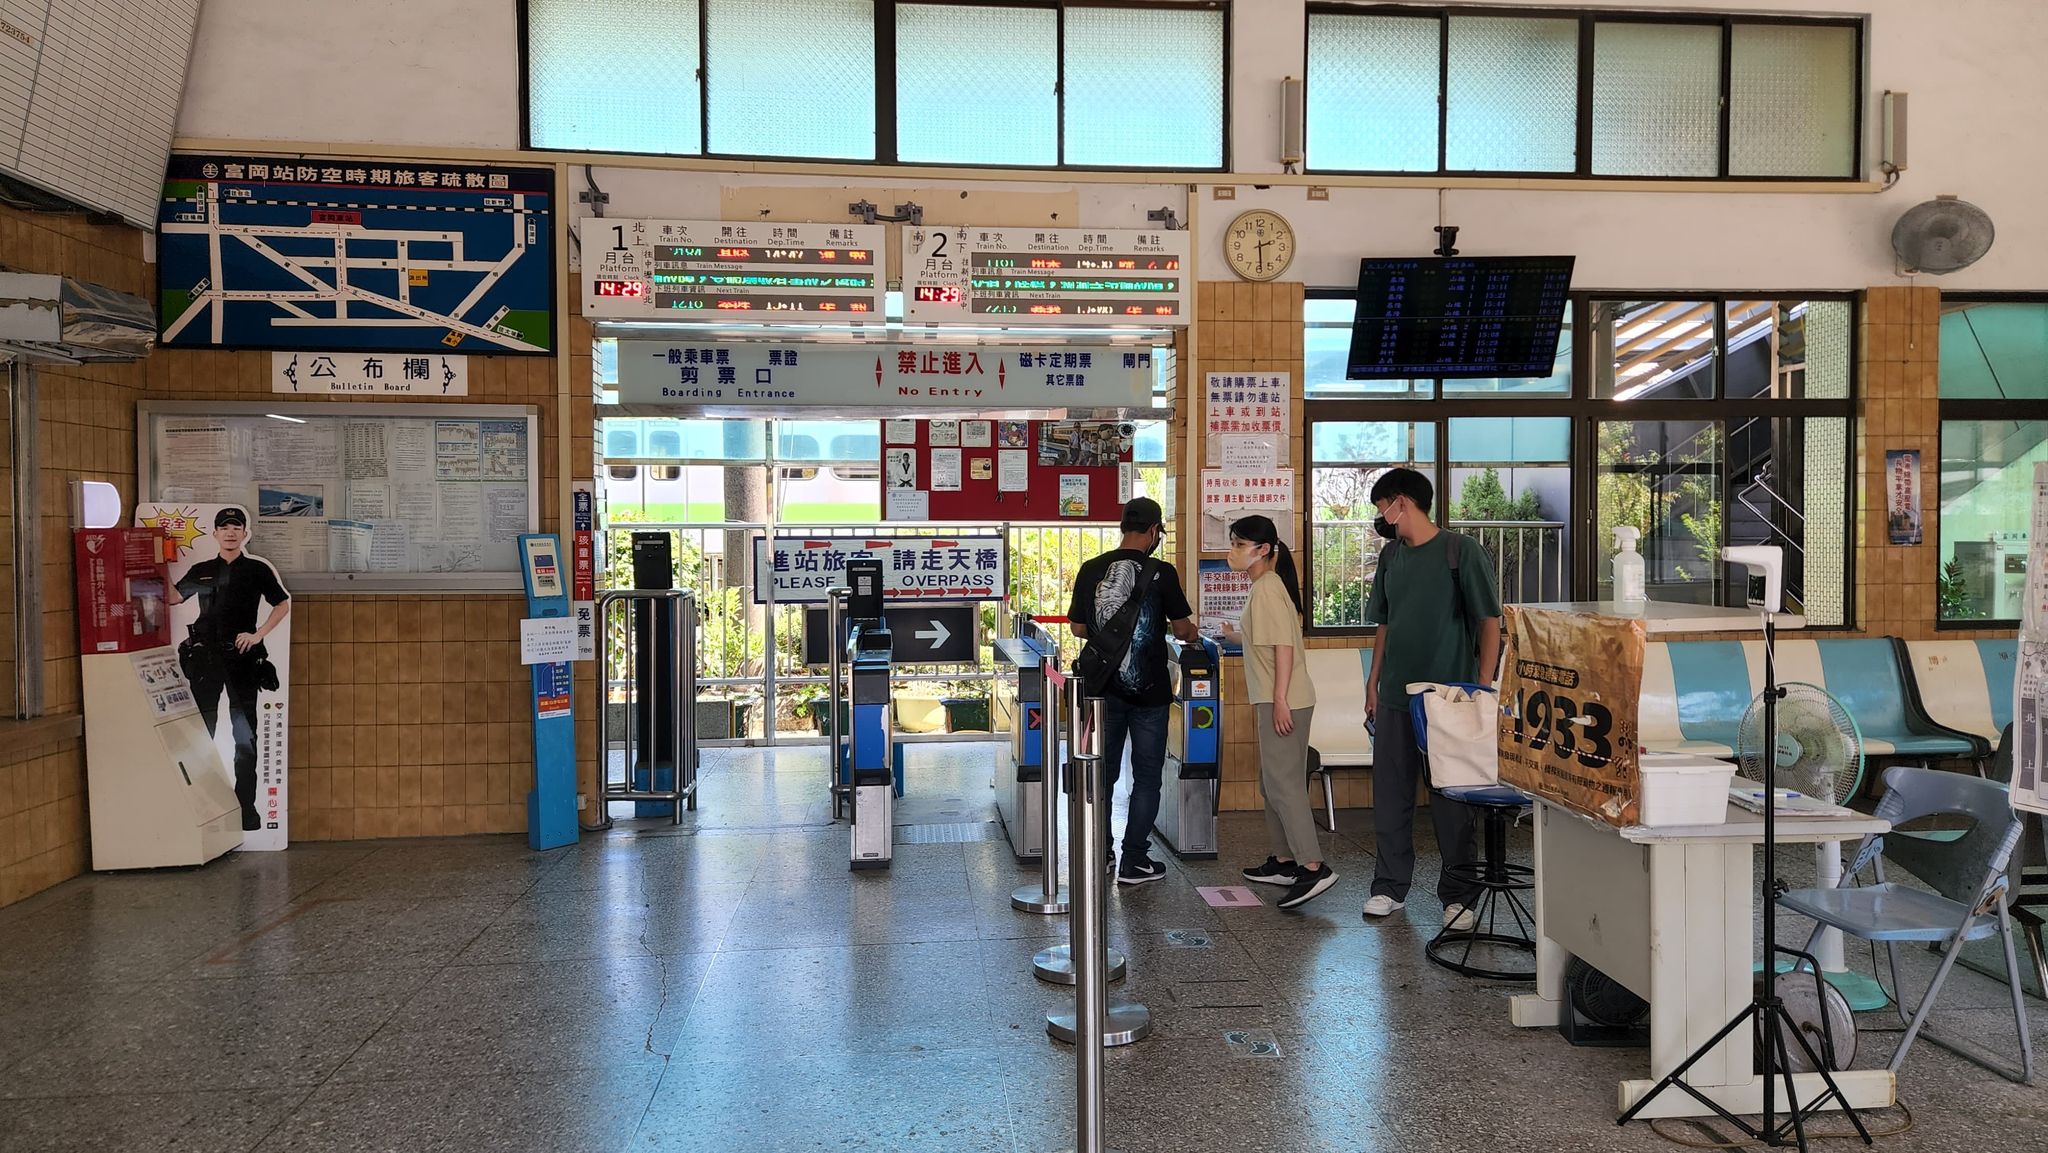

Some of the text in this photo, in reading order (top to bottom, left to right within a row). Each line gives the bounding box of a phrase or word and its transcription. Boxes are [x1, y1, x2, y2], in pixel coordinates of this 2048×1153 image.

[224, 163, 509, 189] 富岡站防空時期旅客疏散圖
[632, 221, 645, 246] 北上
[662, 225, 688, 236] 車次
[721, 226, 747, 237] 開往
[772, 228, 798, 239] 時間
[829, 229, 854, 240] 備註
[612, 226, 629, 251] 1
[659, 235, 679, 243] Train
[714, 237, 758, 245] Destination
[767, 238, 805, 247] Dep.Time
[825, 239, 858, 247] Remarks
[956, 228, 967, 253] 南下
[979, 232, 1003, 243] 車次
[1034, 233, 1060, 244] 開往
[1083, 234, 1107, 244] 時間
[1137, 235, 1161, 245] 備註
[932, 233, 948, 258] 2
[1028, 243, 1069, 251] Destination
[1078, 244, 1114, 252] Dep.Time
[1133, 244, 1165, 252] Remarks
[605, 252, 634, 264] 月台
[600, 264, 640, 272] Platform
[655, 262, 688, 270] 列車訊息
[714, 263, 743, 271] Message
[925, 258, 953, 271] 月台
[920, 271, 958, 279] Platform
[1027, 268, 1055, 276] Message
[599, 282, 642, 296] 14:29
[656, 286, 705, 294] 下班列車資訊
[919, 288, 960, 302] 14:29
[652, 349, 798, 366] 一般乘車票 票證
[897, 350, 985, 376] 禁止進入
[1019, 352, 1093, 369] 磁卡定期票
[310, 356, 430, 380] 公布欄
[681, 366, 772, 385] 剪票口
[1046, 374, 1085, 386] 其它票證
[331, 382, 411, 392] Bulletin Board
[898, 387, 983, 397] No Entry
[662, 388, 795, 398] Boarding Entrance
[159, 517, 186, 529] 安全
[893, 548, 998, 571] 請走天橋
[902, 575, 994, 587] OVERPASS
[578, 607, 591, 638] 免票
[1514, 687, 1612, 769] 1933
